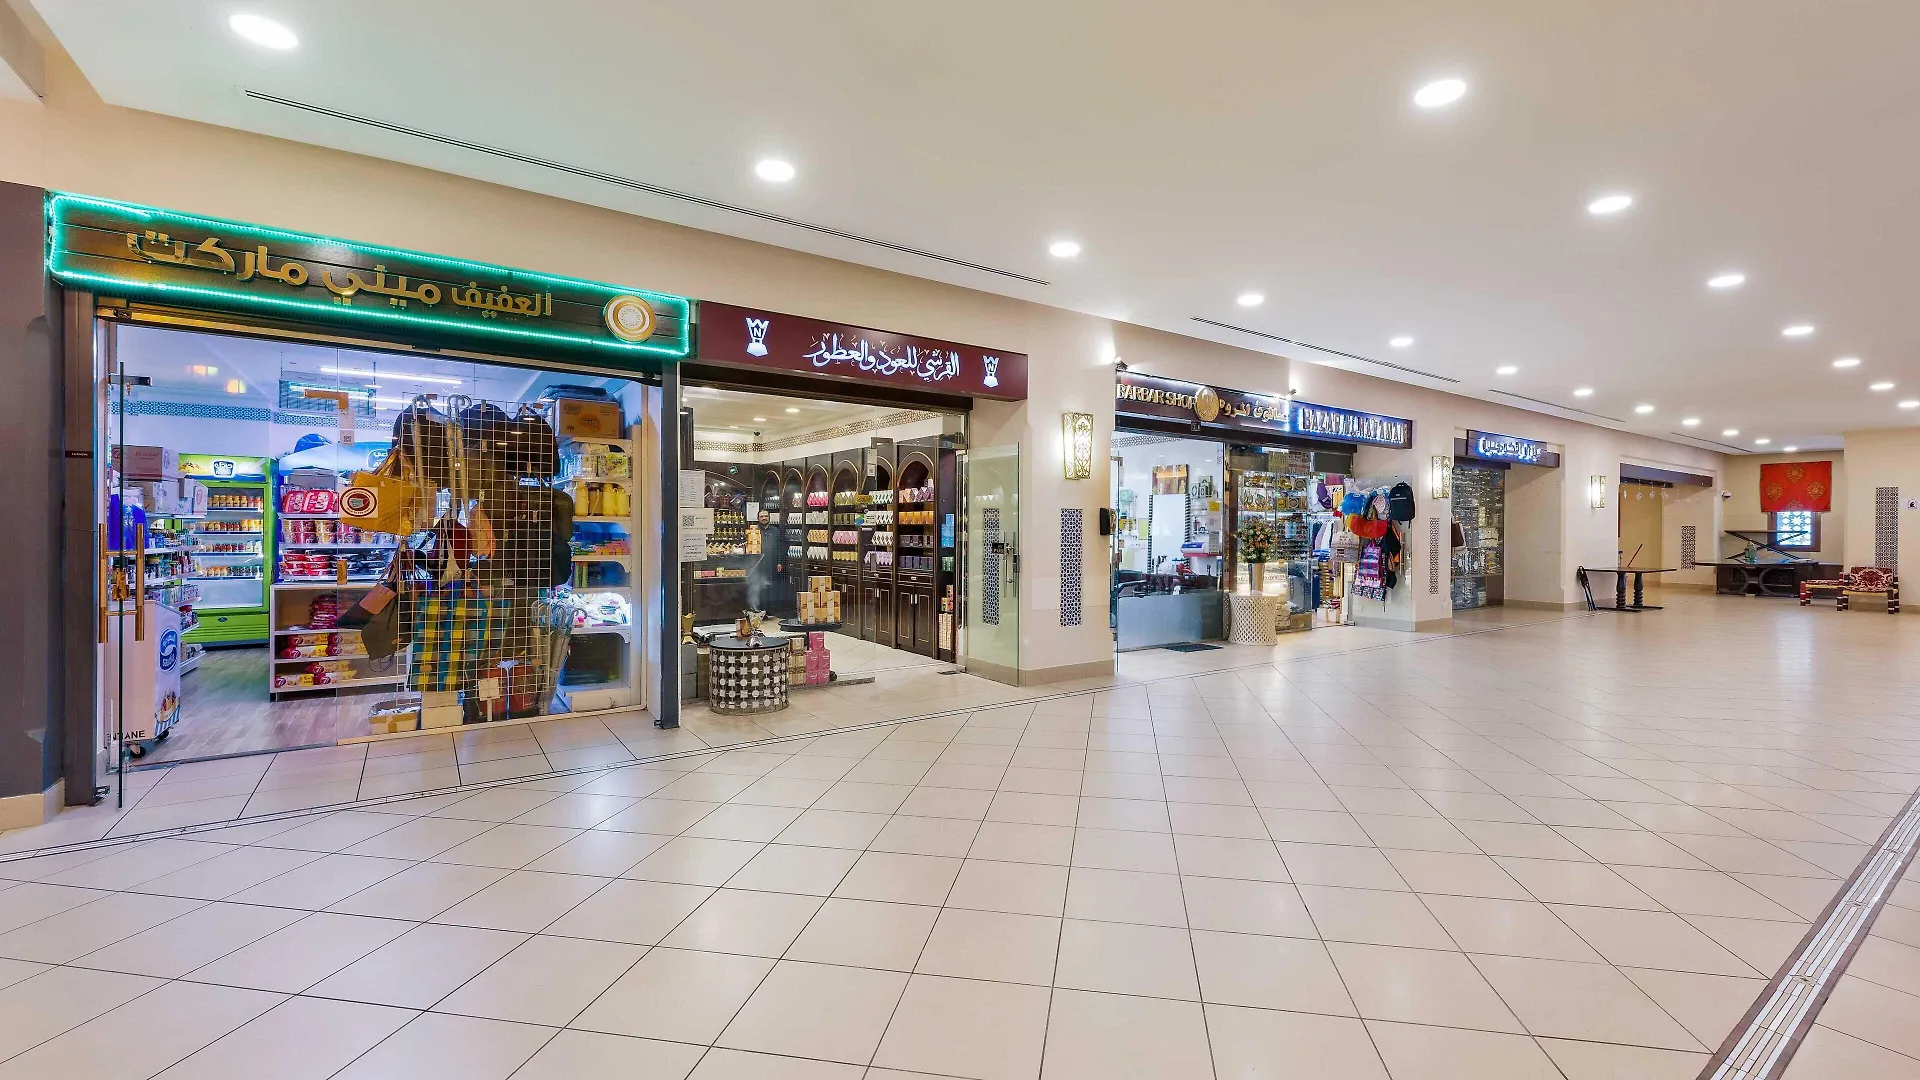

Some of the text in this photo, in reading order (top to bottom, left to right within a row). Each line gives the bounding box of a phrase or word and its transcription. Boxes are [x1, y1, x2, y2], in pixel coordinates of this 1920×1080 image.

[126, 229, 552, 319] العفيف ميني ماركت
[1116, 383, 1164, 405] BARBAR
